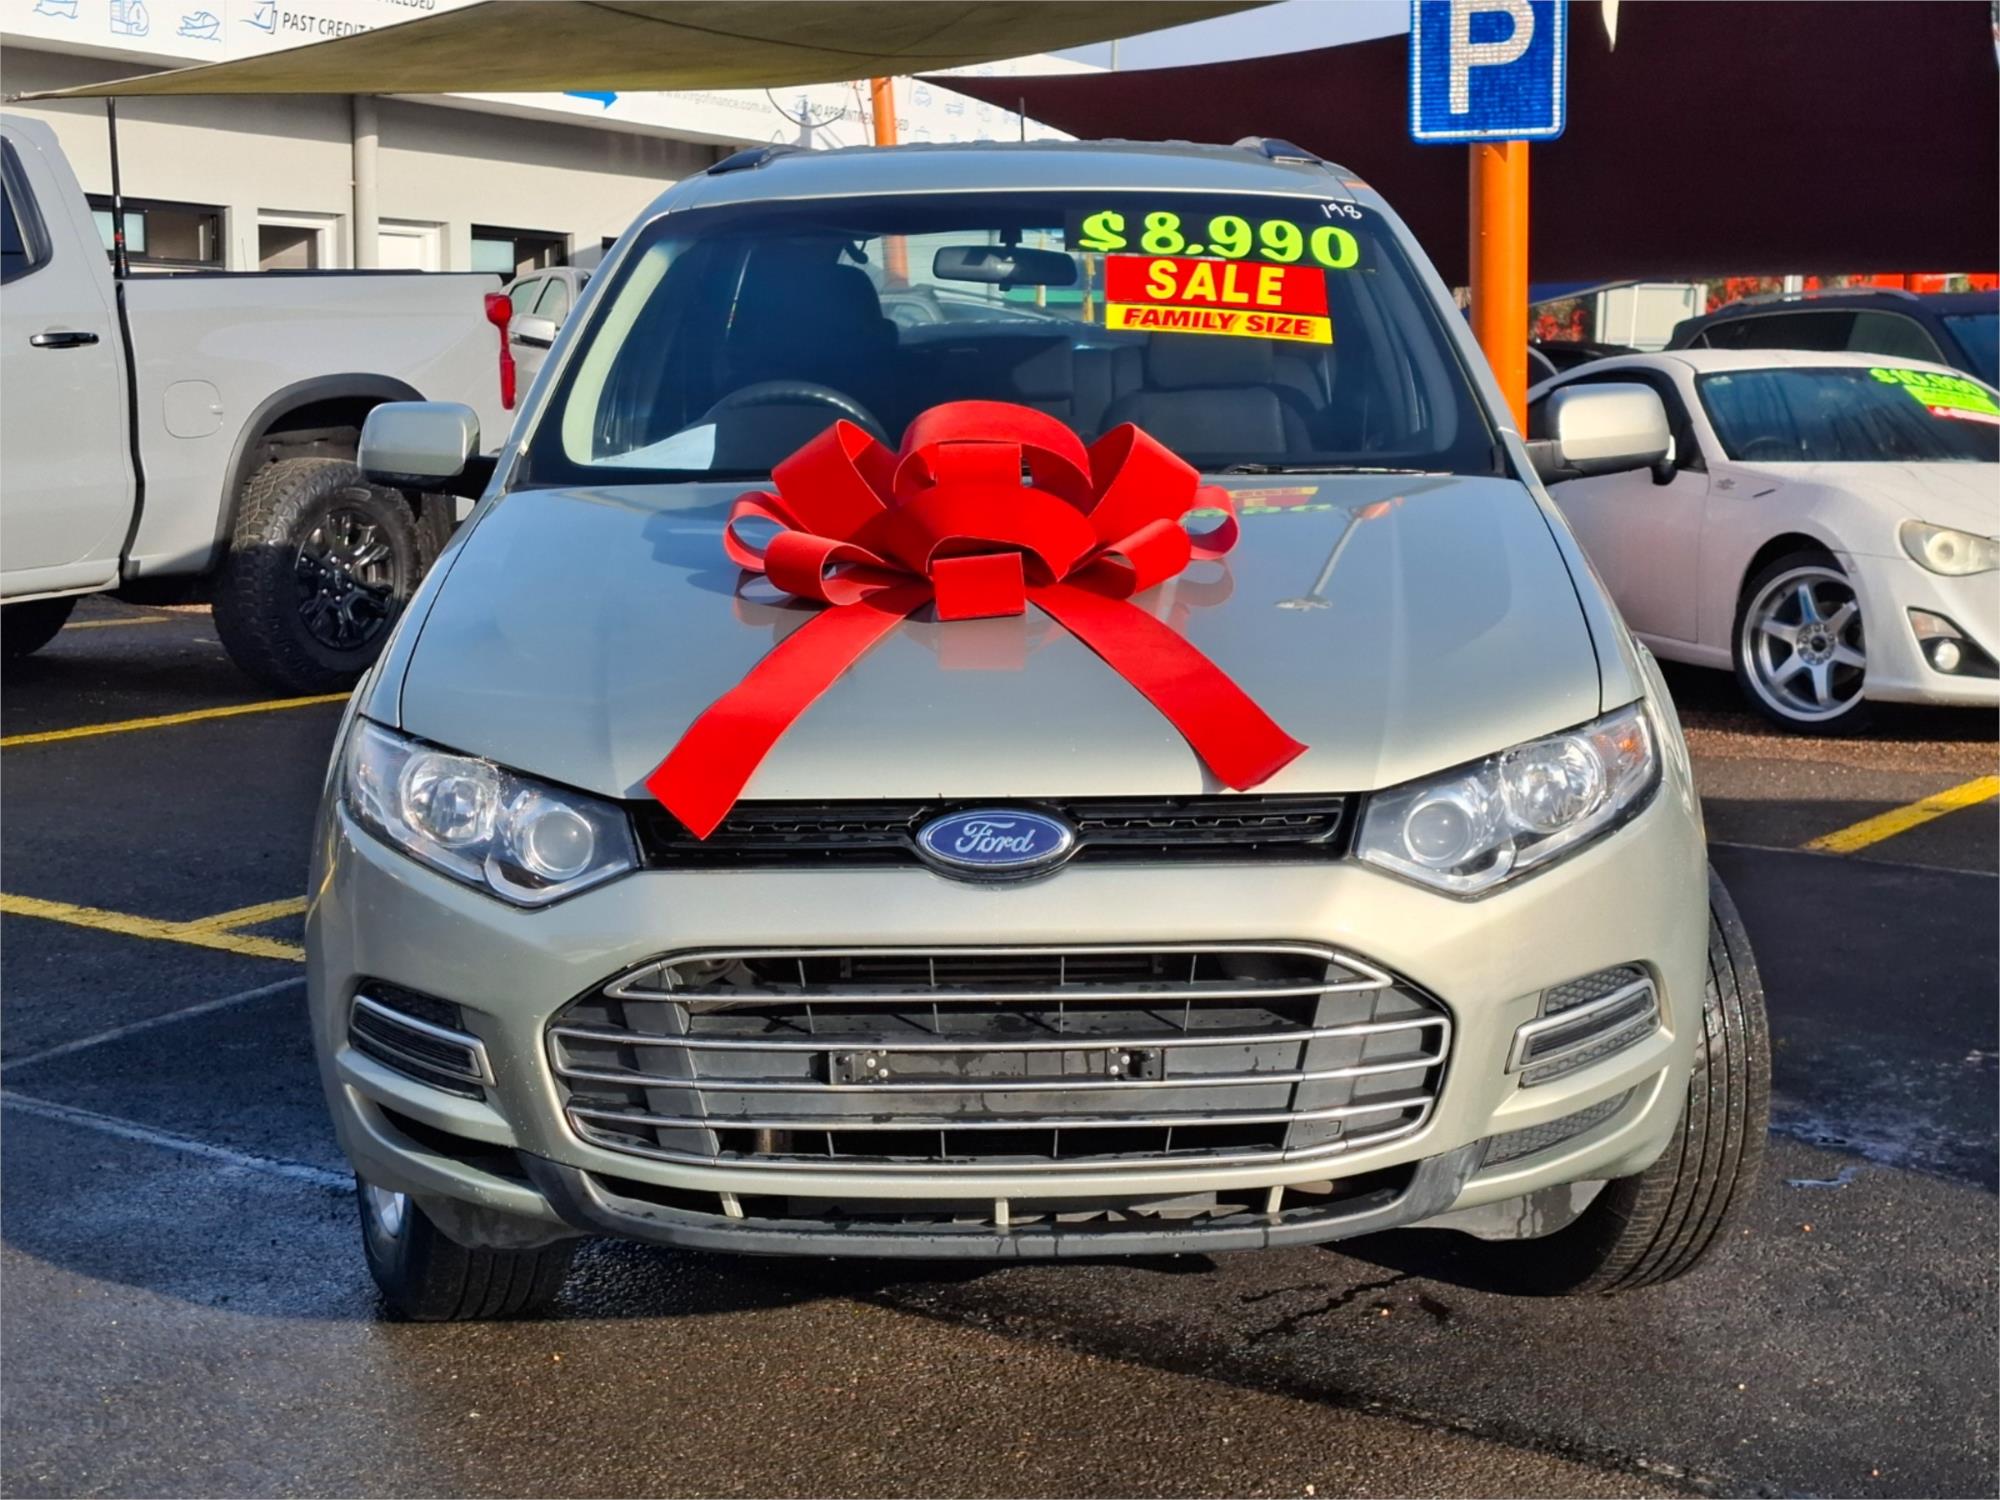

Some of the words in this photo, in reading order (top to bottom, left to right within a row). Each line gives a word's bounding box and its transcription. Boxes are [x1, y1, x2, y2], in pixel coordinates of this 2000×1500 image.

[282, 12, 316, 33] PAST
[318, 18, 365, 37] CREDIT
[1450, 0, 1535, 114] P
[1320, 203, 1363, 220] 198
[1145, 259, 1286, 306] SALE
[1123, 308, 1238, 332] FAMILY
[1245, 316, 1314, 337] SIZE
[955, 820, 1036, 853] Ford
